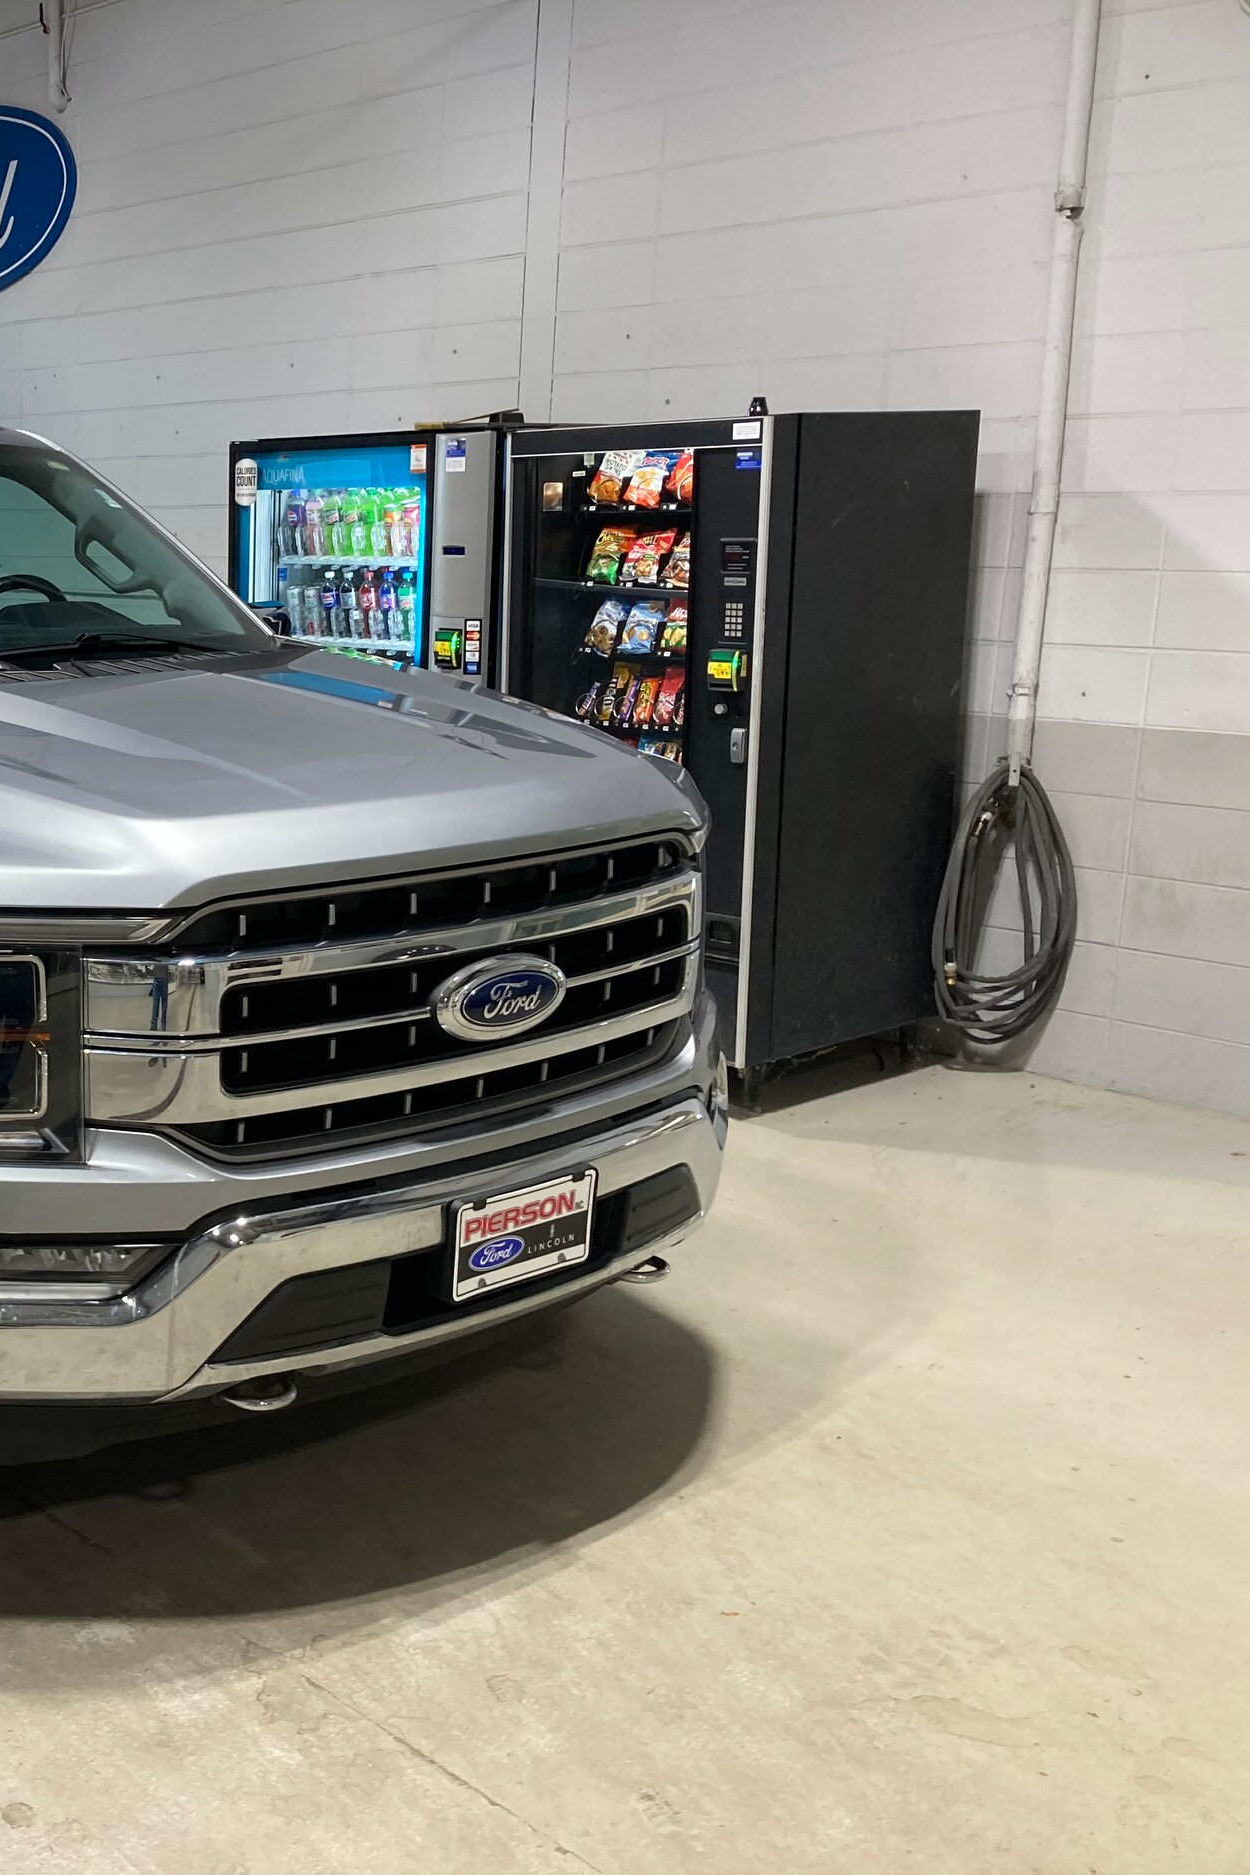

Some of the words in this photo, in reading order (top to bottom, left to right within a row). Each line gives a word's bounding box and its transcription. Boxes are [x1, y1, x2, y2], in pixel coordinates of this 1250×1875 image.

[236, 467, 257, 475] CALORIES
[236, 475, 257, 487] COUNT
[262, 466, 306, 486] AQUAFINA
[483, 980, 543, 1019] Ford
[463, 1188, 577, 1244] PIERSON
[479, 1242, 514, 1266] Ford
[527, 1233, 576, 1254] LINCOLN
